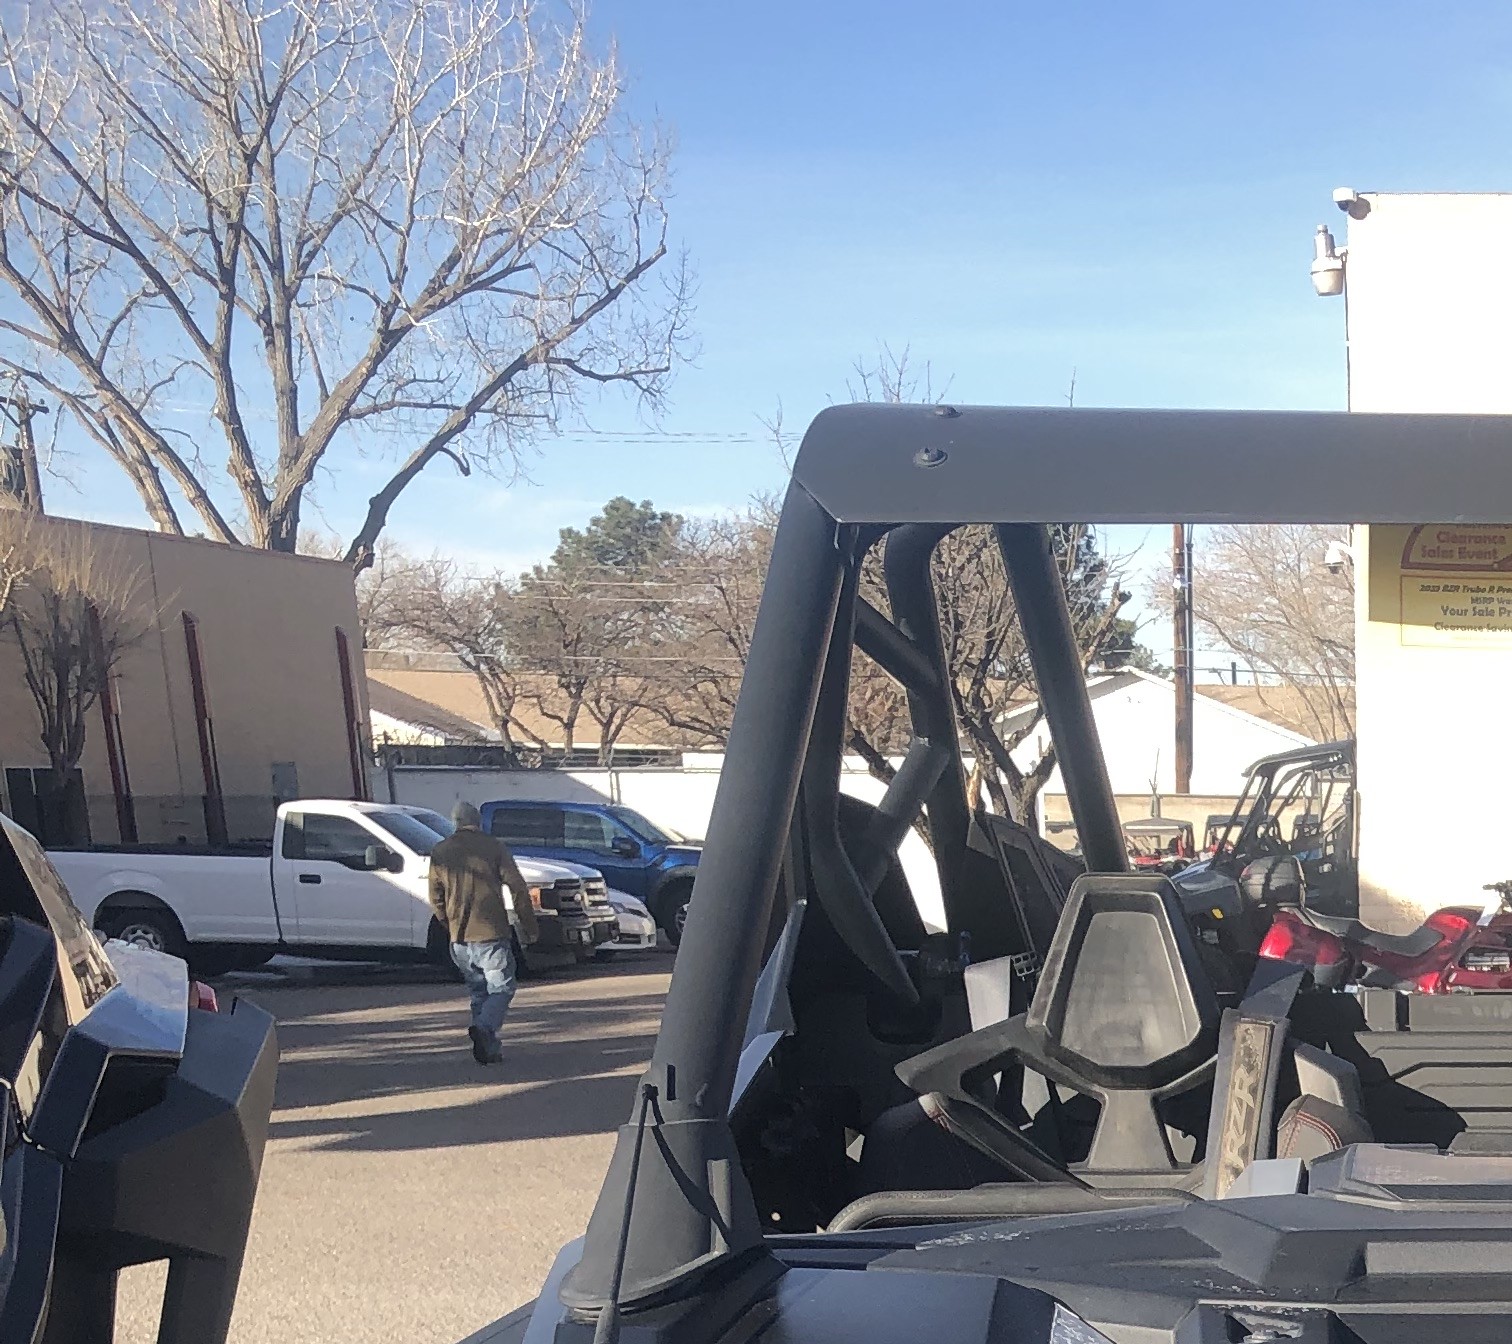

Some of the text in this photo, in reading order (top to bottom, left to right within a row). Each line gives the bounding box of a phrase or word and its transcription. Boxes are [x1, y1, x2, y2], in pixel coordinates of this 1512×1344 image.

[1436, 531, 1506, 544] Clearance
[1421, 545, 1497, 559] Sales Event
[1441, 605, 1468, 616] Your
[1472, 606, 1495, 616] Sale
[1434, 622, 1483, 632] Clearance
[1226, 1063, 1255, 1168] RZR
